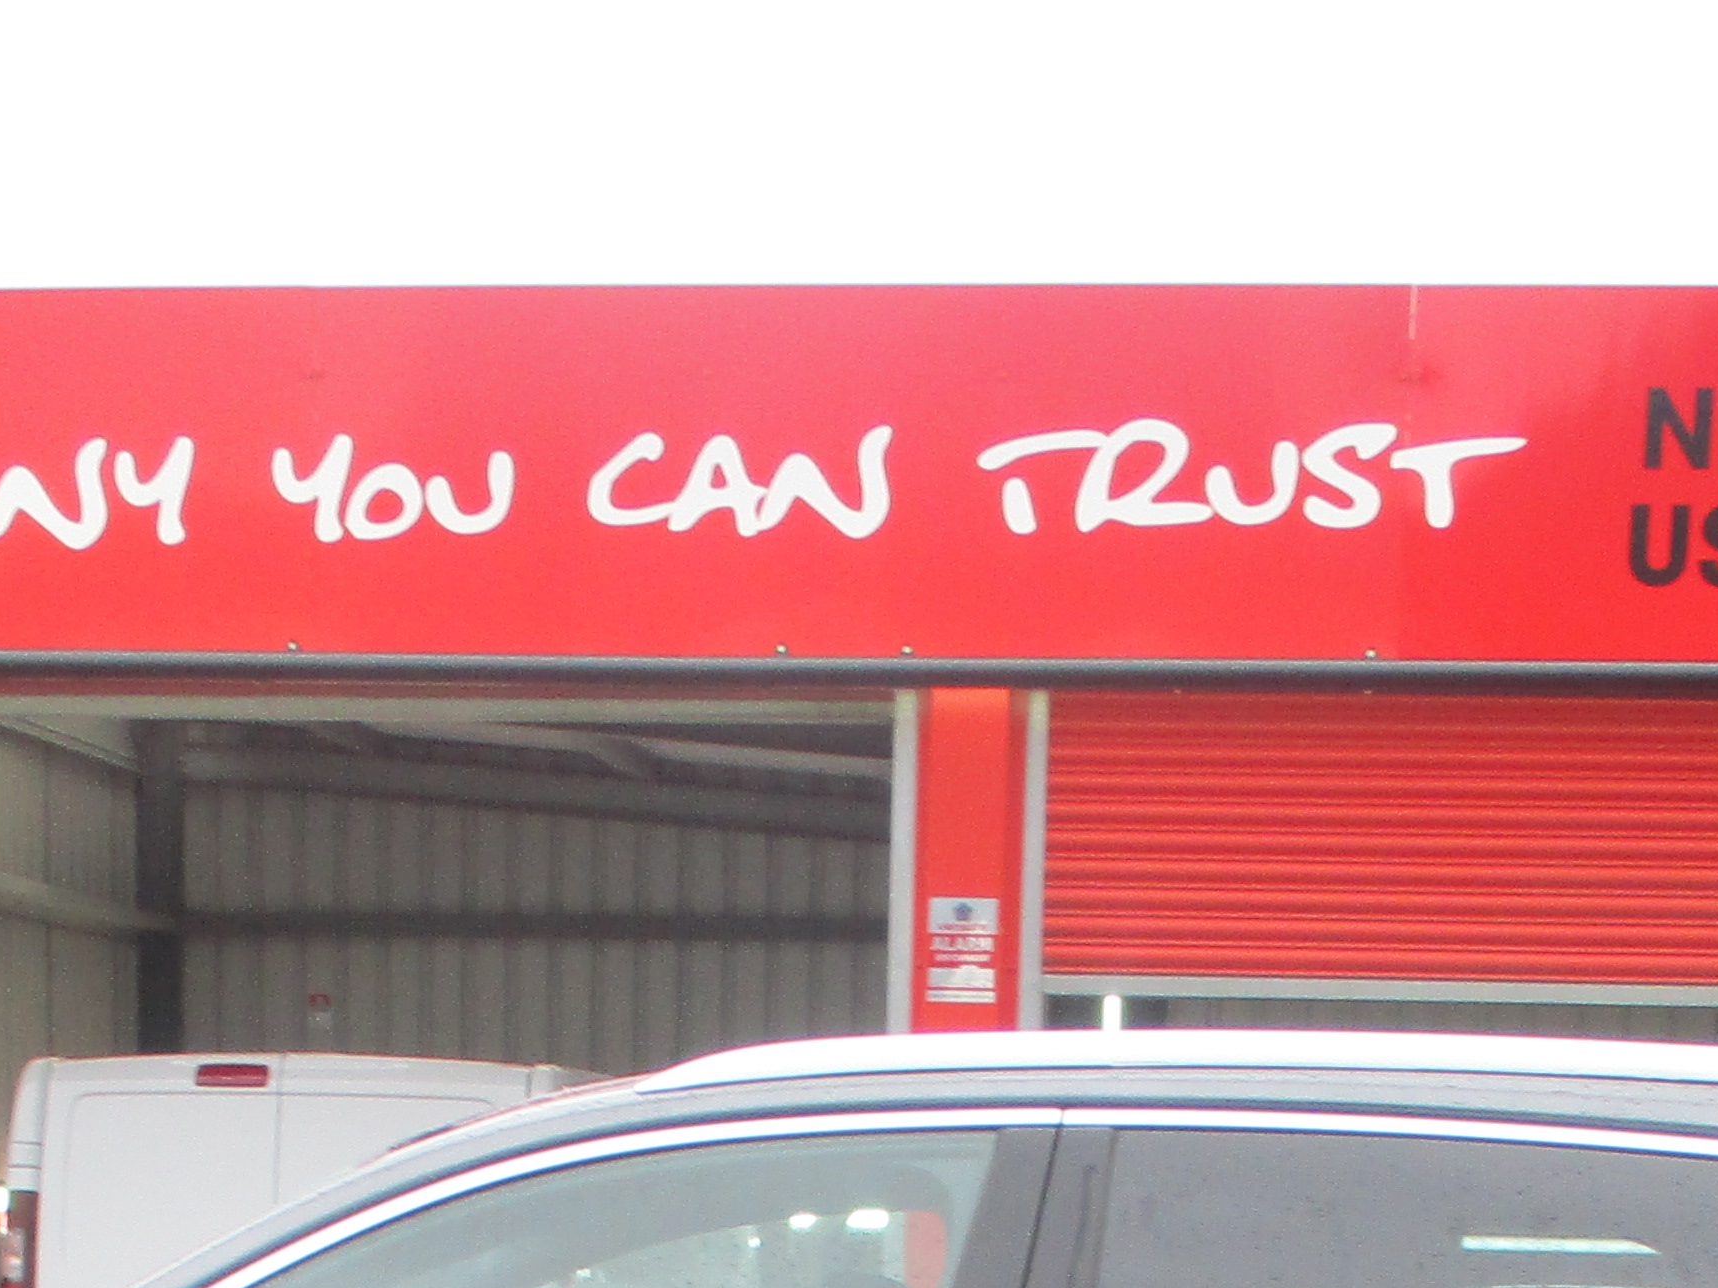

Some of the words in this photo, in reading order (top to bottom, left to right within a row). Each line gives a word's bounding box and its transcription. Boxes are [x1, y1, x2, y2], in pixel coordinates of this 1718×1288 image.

[270, 432, 516, 544] YOU
[585, 424, 894, 540] CAN
[975, 417, 1529, 536] TRUST
